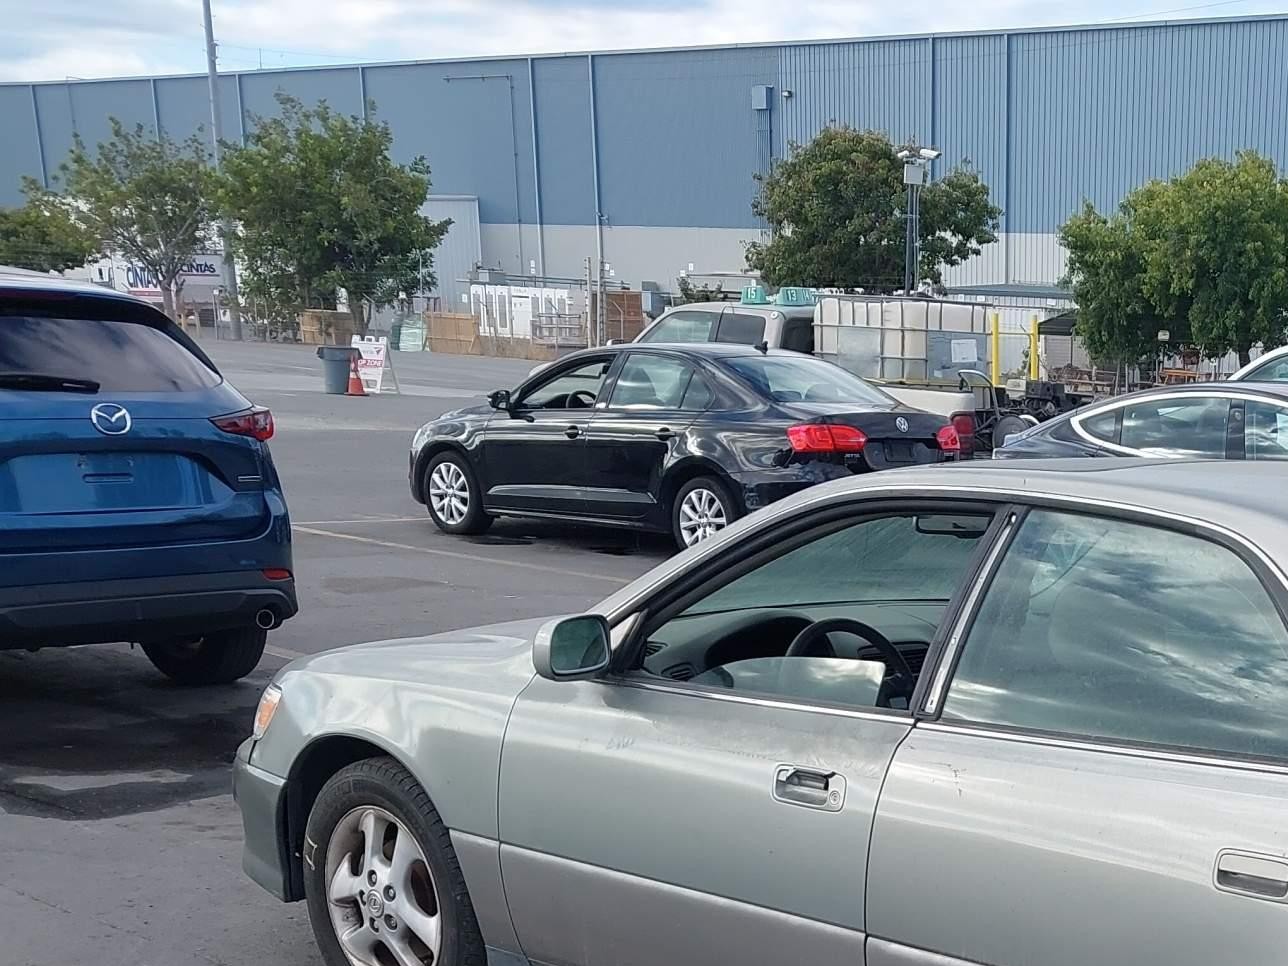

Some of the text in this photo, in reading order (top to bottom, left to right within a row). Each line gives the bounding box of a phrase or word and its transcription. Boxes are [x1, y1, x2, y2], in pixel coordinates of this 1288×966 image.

[181, 263, 216, 273] CINTAS
[747, 287, 757, 299] 15
[787, 289, 797, 301] 13
